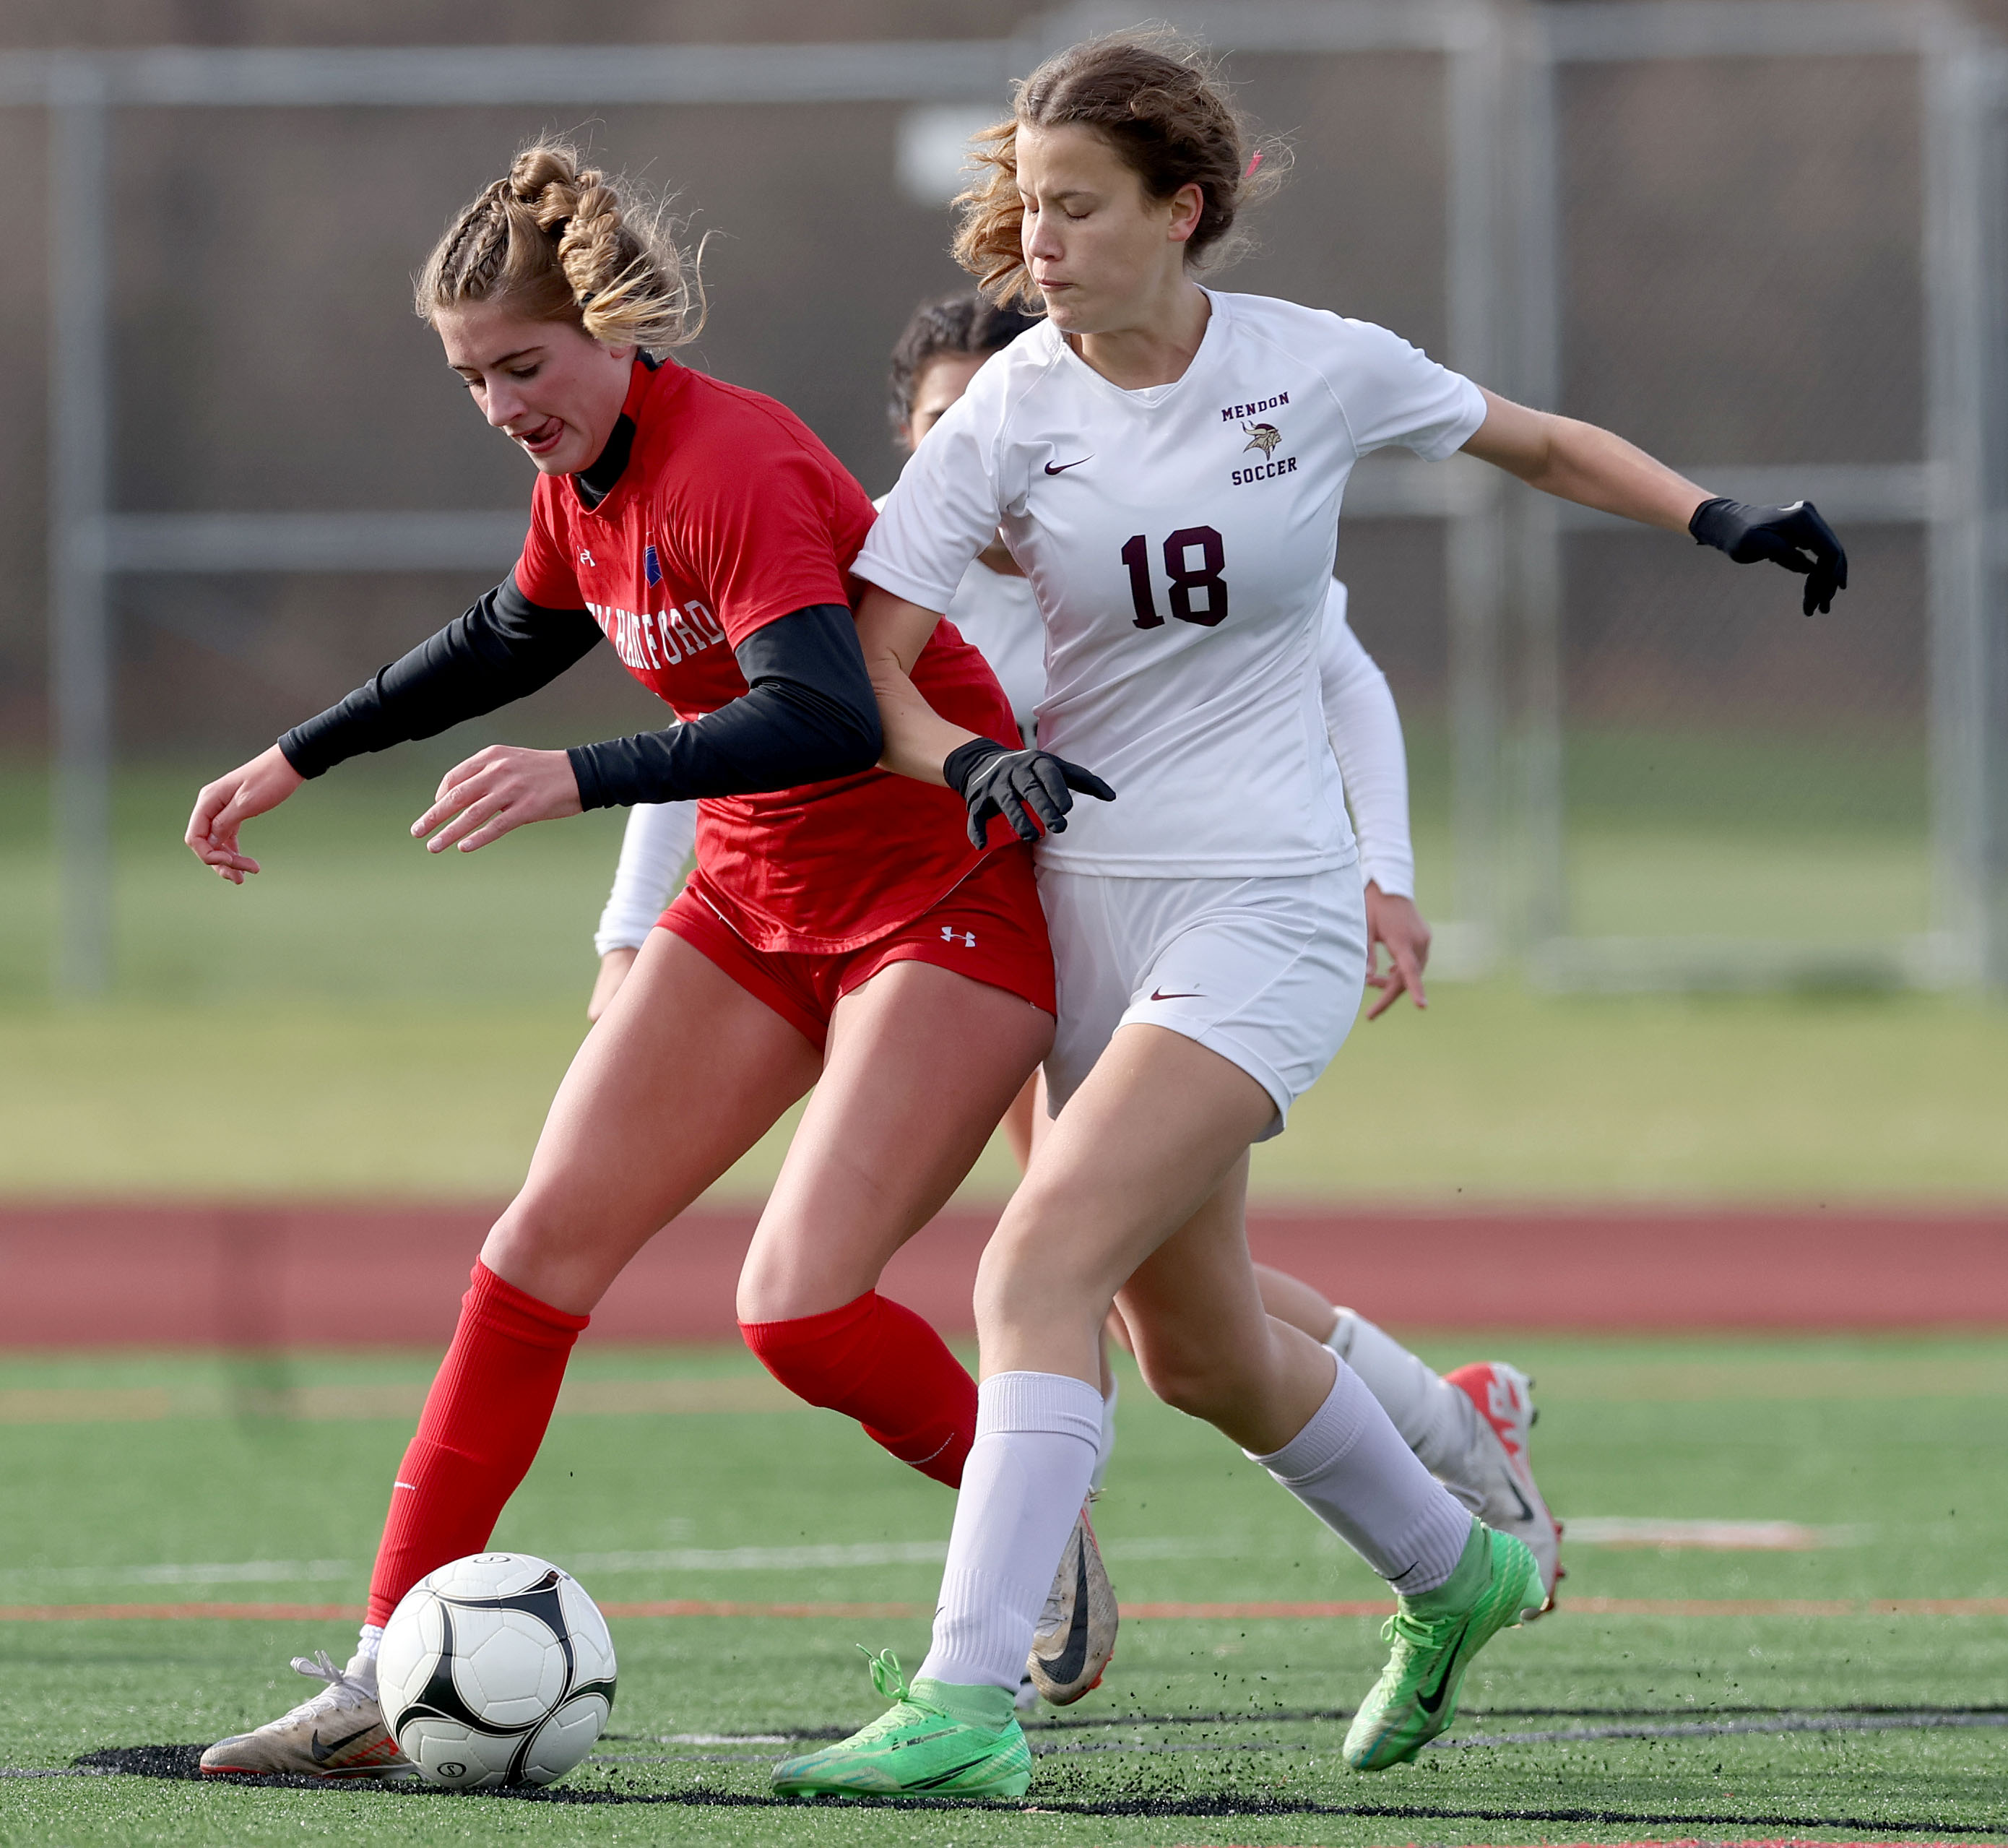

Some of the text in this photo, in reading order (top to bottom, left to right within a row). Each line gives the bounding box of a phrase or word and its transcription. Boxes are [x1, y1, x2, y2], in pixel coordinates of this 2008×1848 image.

[1221, 392, 1289, 422] MENDON
[1232, 457, 1297, 485] SOCCER
[1121, 525, 1228, 629] 18
